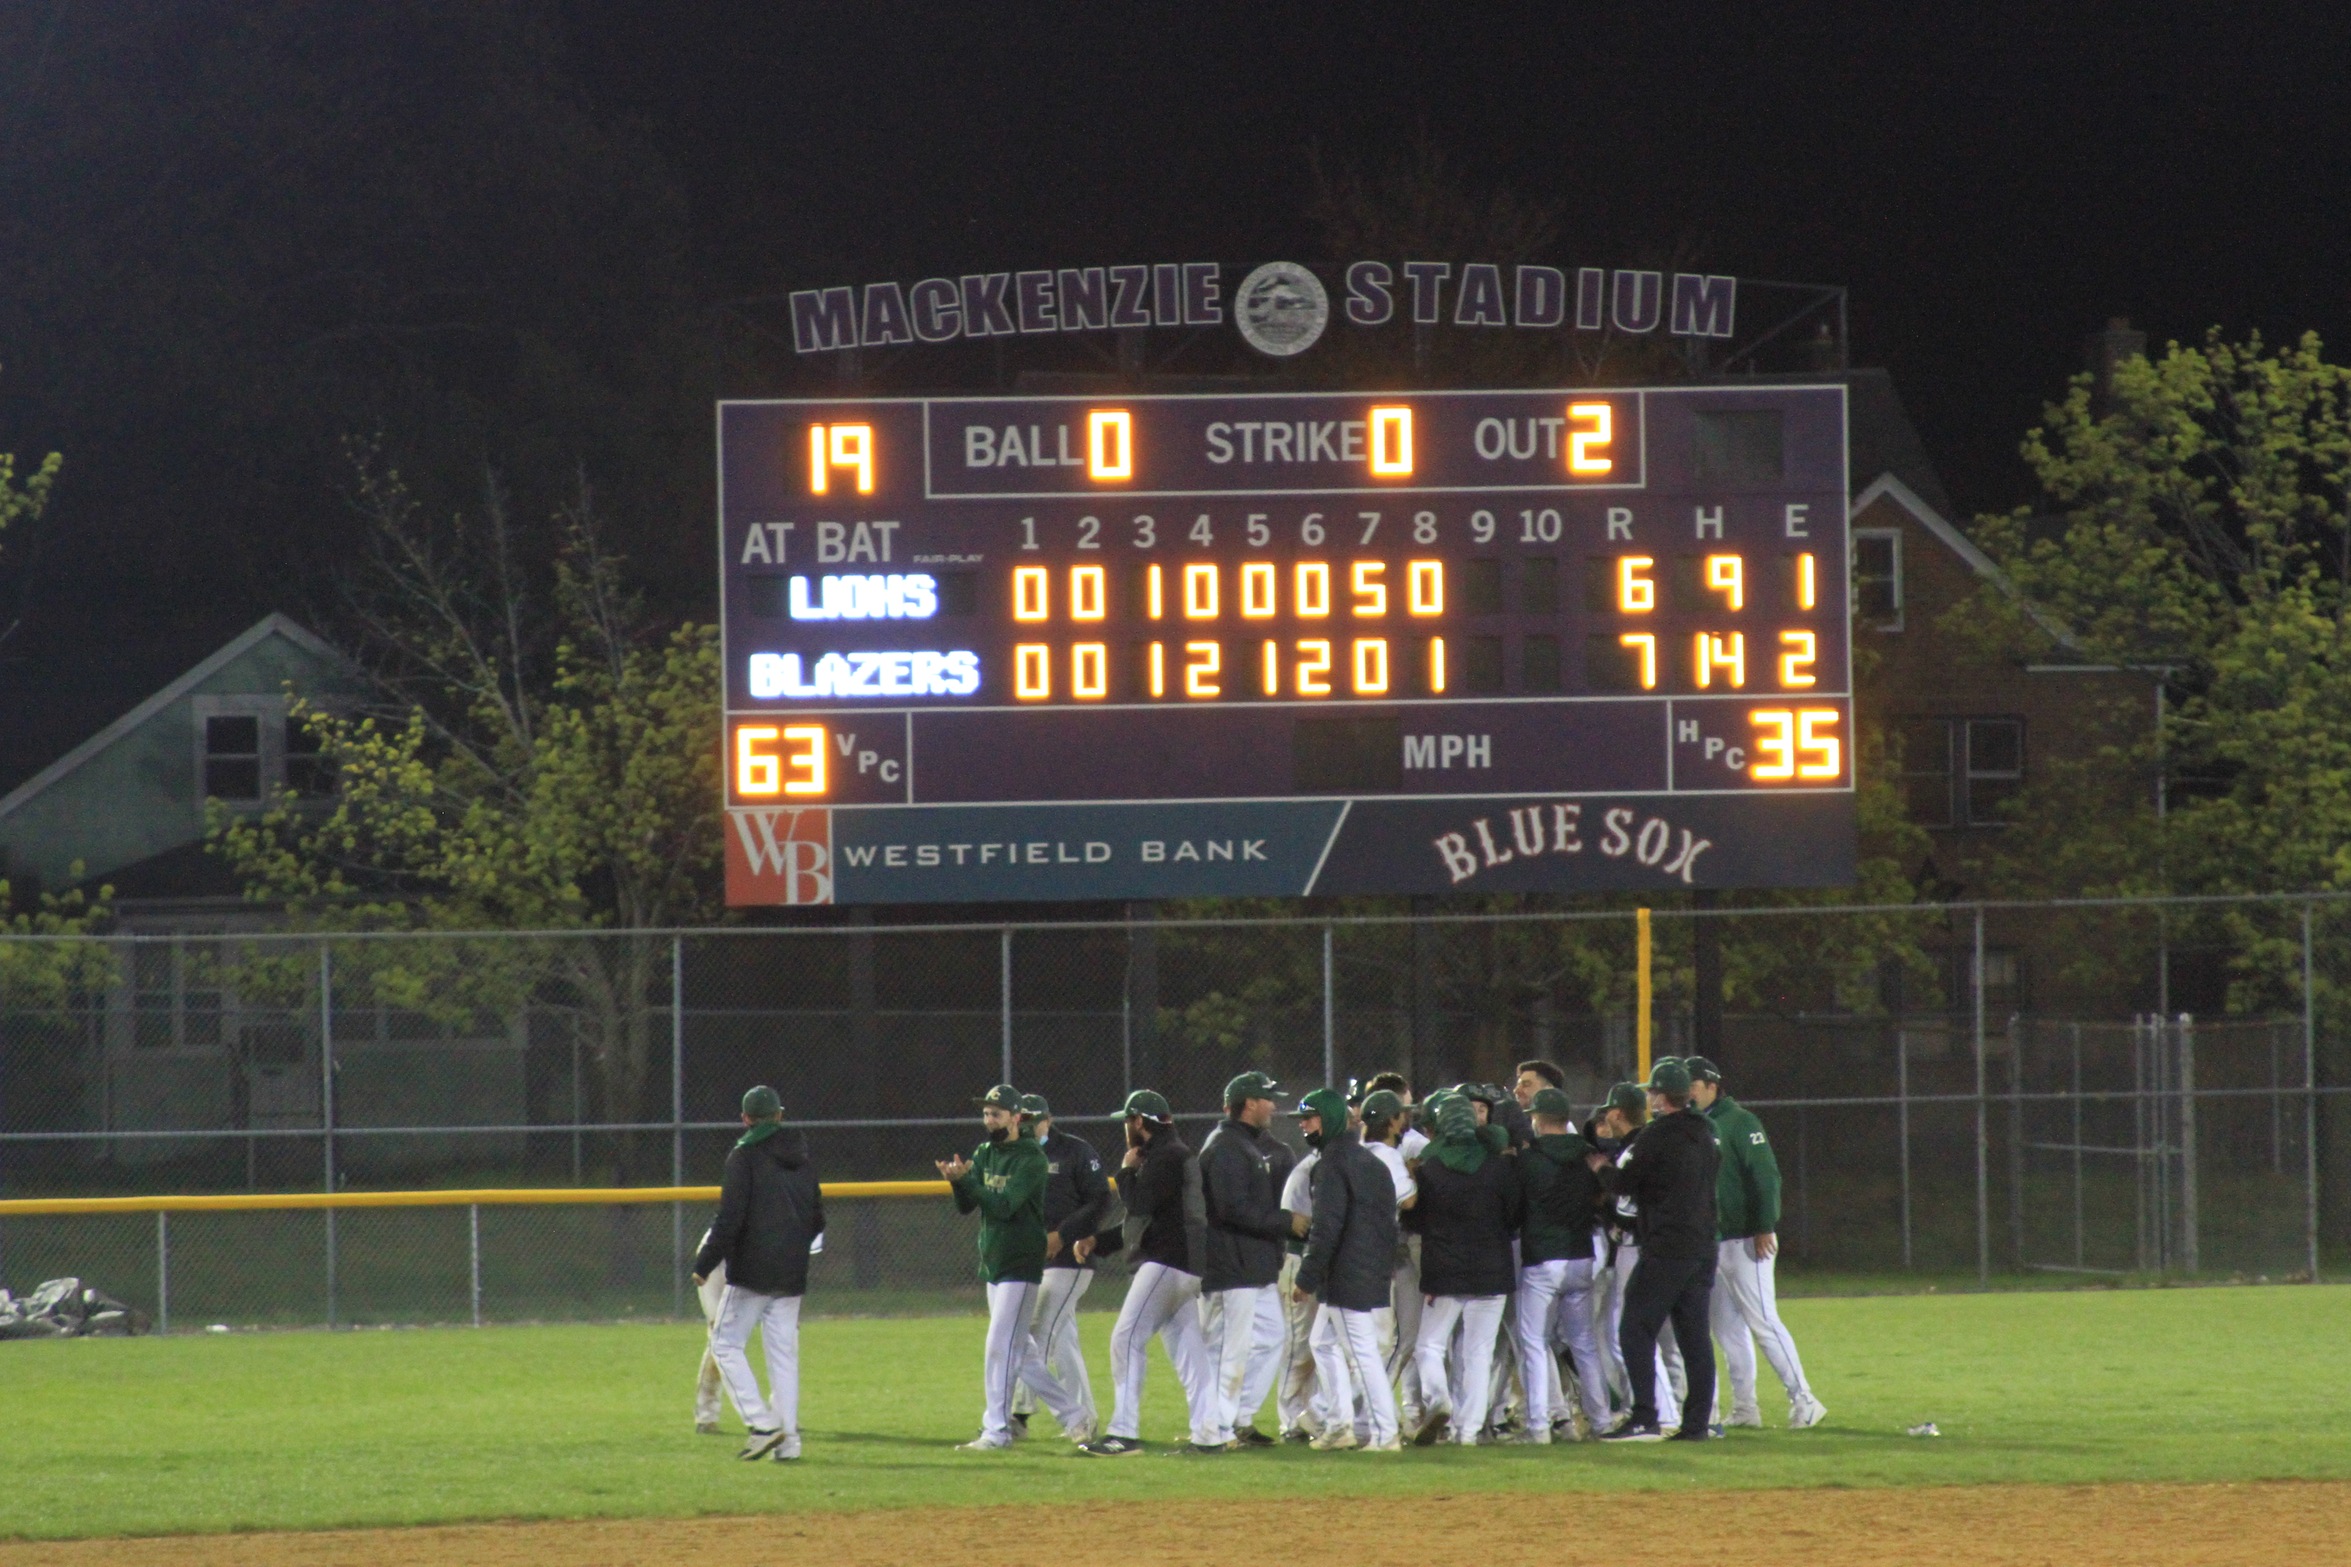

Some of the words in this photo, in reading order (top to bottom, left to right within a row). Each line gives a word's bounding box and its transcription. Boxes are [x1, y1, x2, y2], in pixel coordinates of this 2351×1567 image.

[789, 262, 1223, 353] MACKENZIE
[1345, 260, 1737, 338] STADIUM
[810, 422, 874, 494] 19
[965, 425, 1085, 468] BALL
[1087, 408, 1132, 480] 0
[1206, 420, 1367, 464] STRIKE
[1370, 404, 1413, 476] 0
[1474, 416, 1565, 460] OUT
[1568, 402, 1611, 473] 2
[741, 522, 794, 564] AT
[817, 521, 900, 563] BAT
[1022, 517, 1039, 549] 1
[1077, 516, 1100, 549] 2
[1133, 515, 1156, 548] 3
[1189, 514, 1213, 546] 4
[1247, 513, 1270, 547] 5
[1302, 513, 1325, 546] 6
[1358, 512, 1381, 544] 7
[1414, 511, 1437, 544] 8
[1471, 510, 1495, 542] 9
[1520, 509, 1562, 542] 10
[1608, 507, 1633, 540] R
[1696, 506, 1723, 539] H
[1786, 504, 1809, 537] E
[790, 574, 938, 619] LIONS
[1013, 565, 1047, 621] 0
[1070, 565, 1105, 620] 0
[1150, 564, 1162, 619] 1
[1184, 563, 1218, 618] 0
[1241, 562, 1275, 618] 0
[1295, 561, 1329, 617] 0
[1352, 560, 1386, 617] 5
[1408, 560, 1443, 616] 0
[1619, 556, 1654, 612] 6
[1706, 554, 1743, 611] 9
[1799, 553, 1814, 610] 1
[750, 650, 981, 698] BLAZERS
[1015, 643, 1049, 699] 0
[1072, 642, 1106, 698] 0
[1151, 641, 1163, 697] 1
[1185, 640, 1220, 696] 2
[1263, 640, 1277, 695] 1
[1296, 639, 1330, 694] 2
[1353, 638, 1388, 693] 0
[1431, 637, 1444, 692] 1
[1620, 633, 1655, 689] 7
[1696, 632, 1744, 688] 14
[1778, 631, 1815, 687] 2
[737, 725, 827, 796] 63
[1403, 735, 1492, 769] MPH
[1749, 707, 1840, 780] 35
[845, 842, 1111, 866] WESTFIELD
[1142, 840, 1268, 862] BANK
[1434, 805, 1582, 884] BLUE
[1600, 808, 1711, 883] SOX
